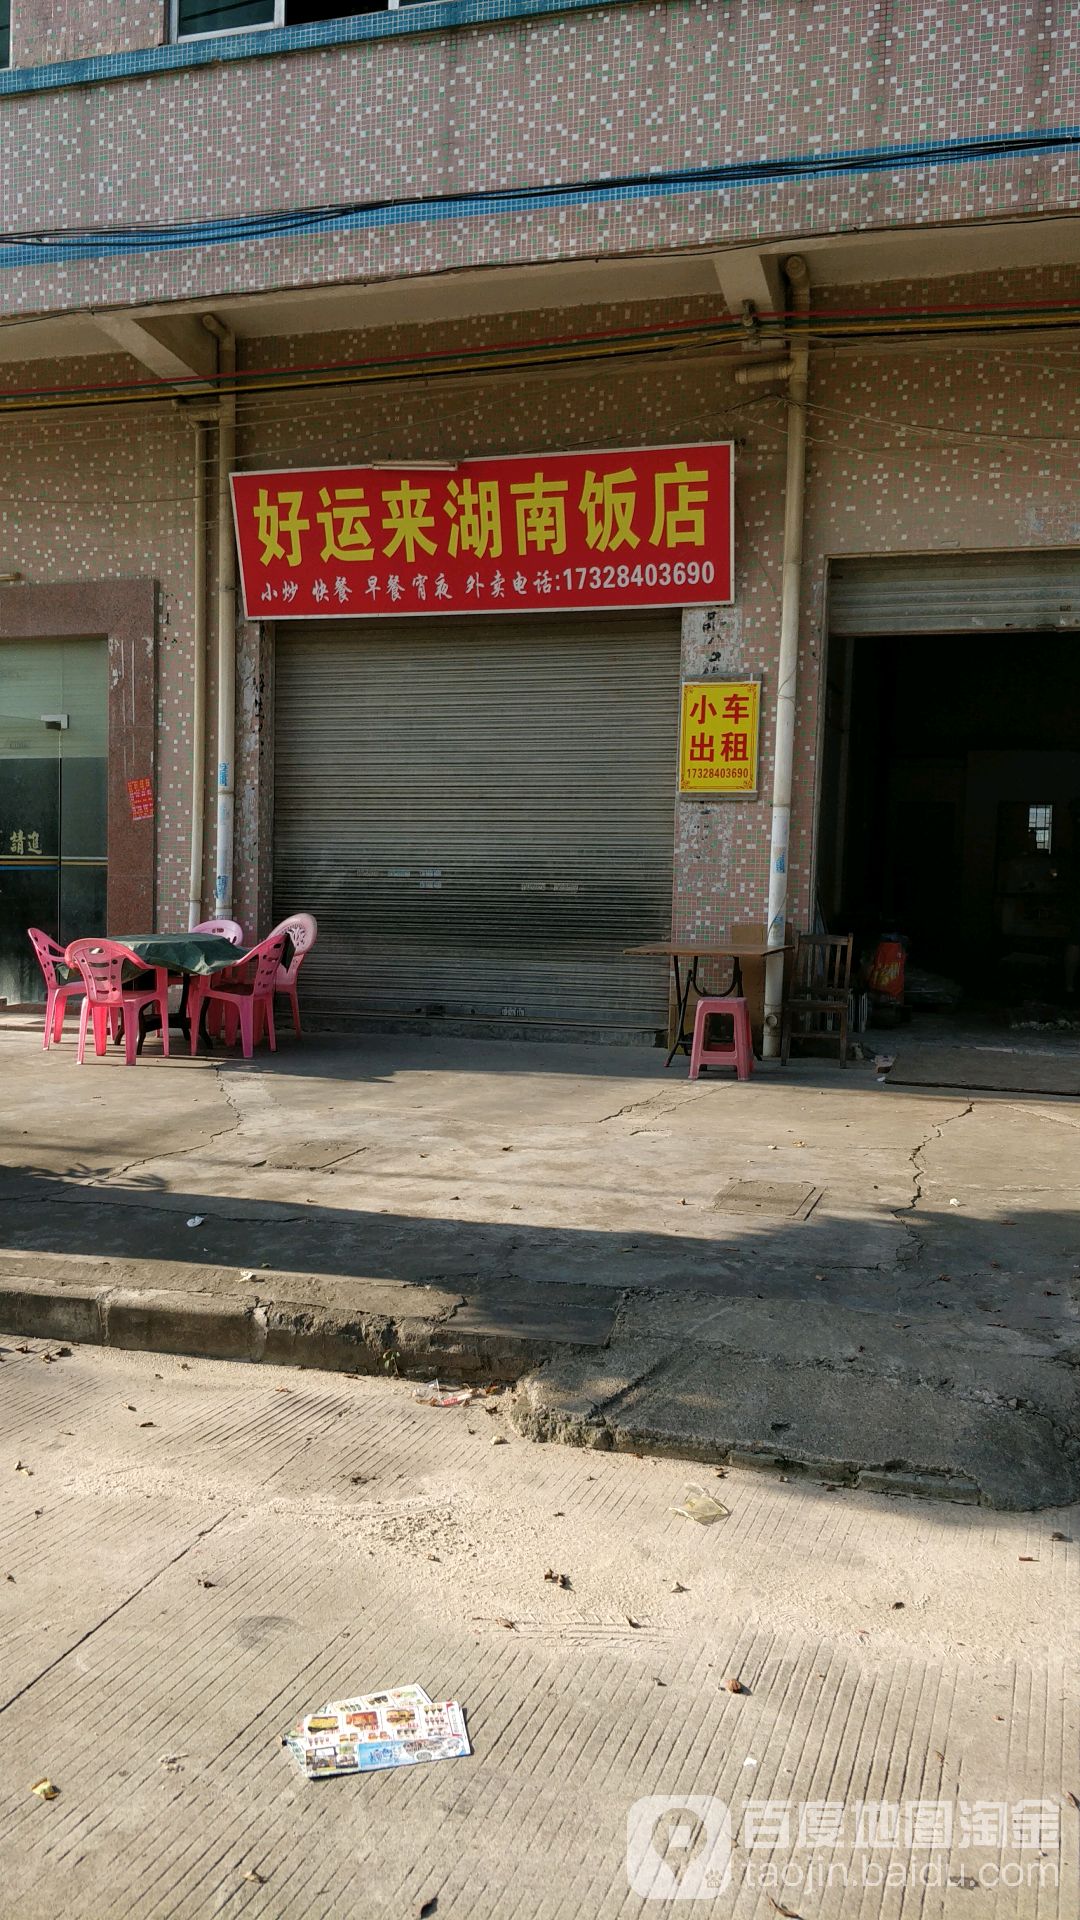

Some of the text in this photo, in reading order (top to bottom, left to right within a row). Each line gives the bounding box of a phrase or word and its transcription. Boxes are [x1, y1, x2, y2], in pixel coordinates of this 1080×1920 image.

[254, 461, 709, 568] 好运来湖南饭店
[261, 579, 299, 602] 小炒
[312, 575, 353, 604] 快餐
[690, 693, 749, 725] 小车
[690, 732, 748, 763] 出租
[687, 768, 749, 780] 17328403690
[9, 829, 43, 856] 請進
